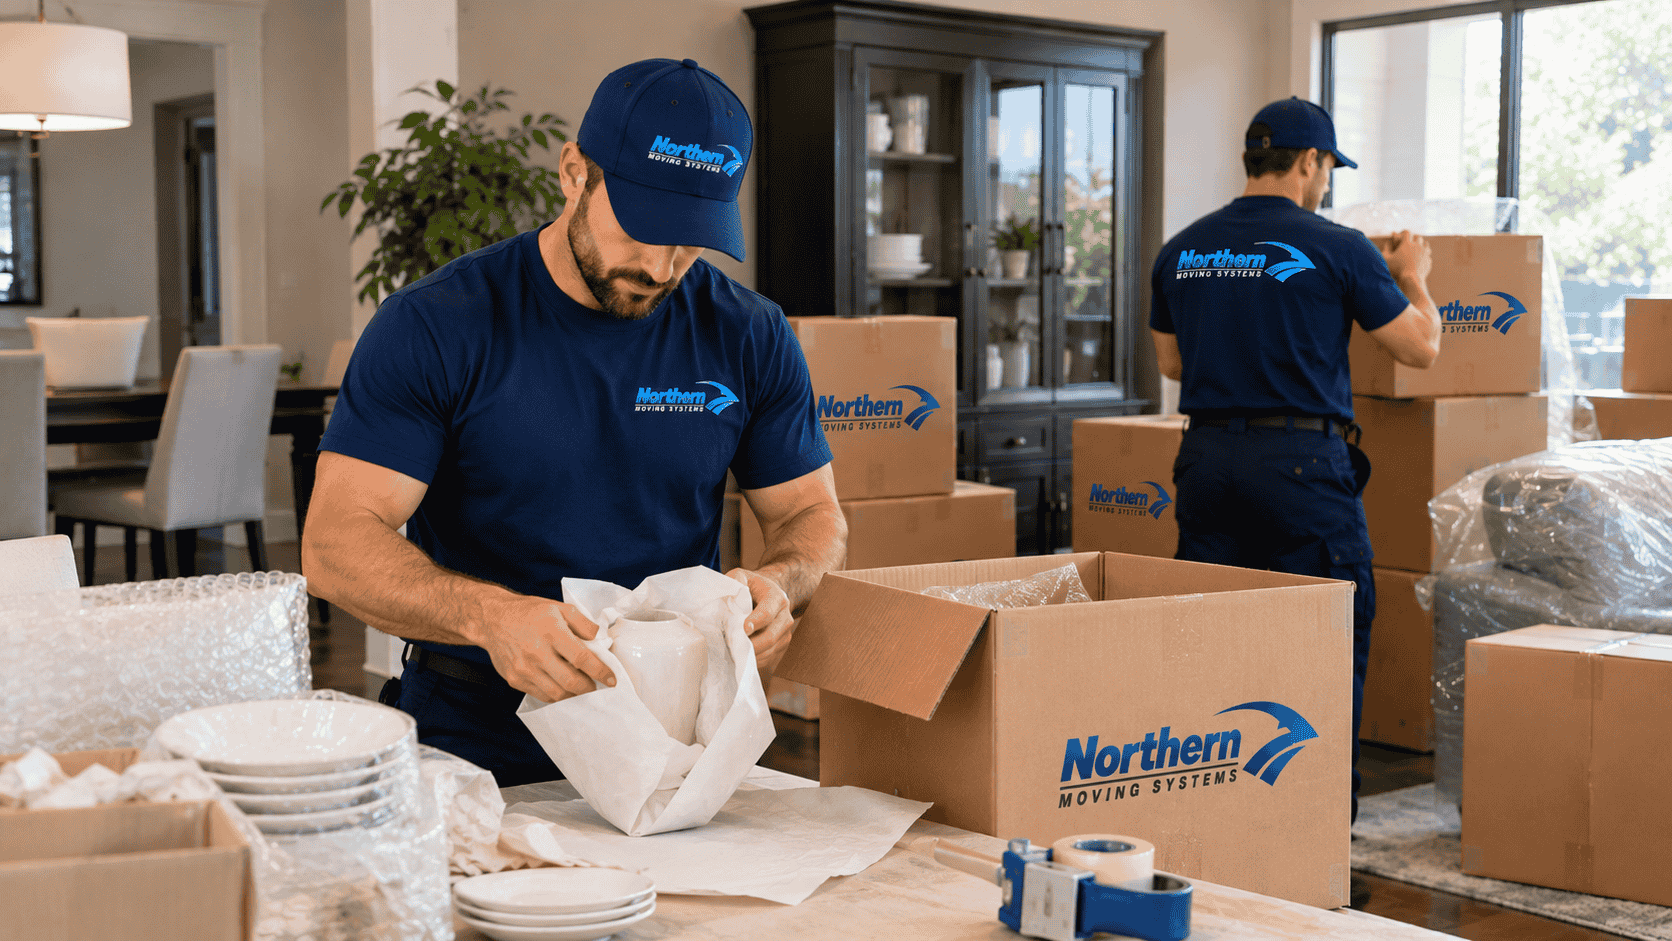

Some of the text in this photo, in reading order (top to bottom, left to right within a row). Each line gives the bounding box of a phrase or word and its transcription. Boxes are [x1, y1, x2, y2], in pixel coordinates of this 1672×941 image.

[650, 134, 725, 165] Northern
[647, 153, 721, 173] MOVING SYSTEMS
[1176, 248, 1267, 270] Northern
[1176, 270, 1262, 279] MOVING SYSTEMS
[1437, 299, 1492, 322] rthern
[1450, 325, 1489, 333] SYSTEMS
[635, 387, 706, 404] Northern
[817, 393, 903, 418] Northern
[634, 405, 704, 413] MOVING SYSTEMS
[821, 420, 902, 432] OVING SYSTEMS
[1089, 483, 1148, 506] Northern
[1060, 726, 1242, 782] Northern
[1058, 768, 1238, 808] MOVING SYSTEMS
